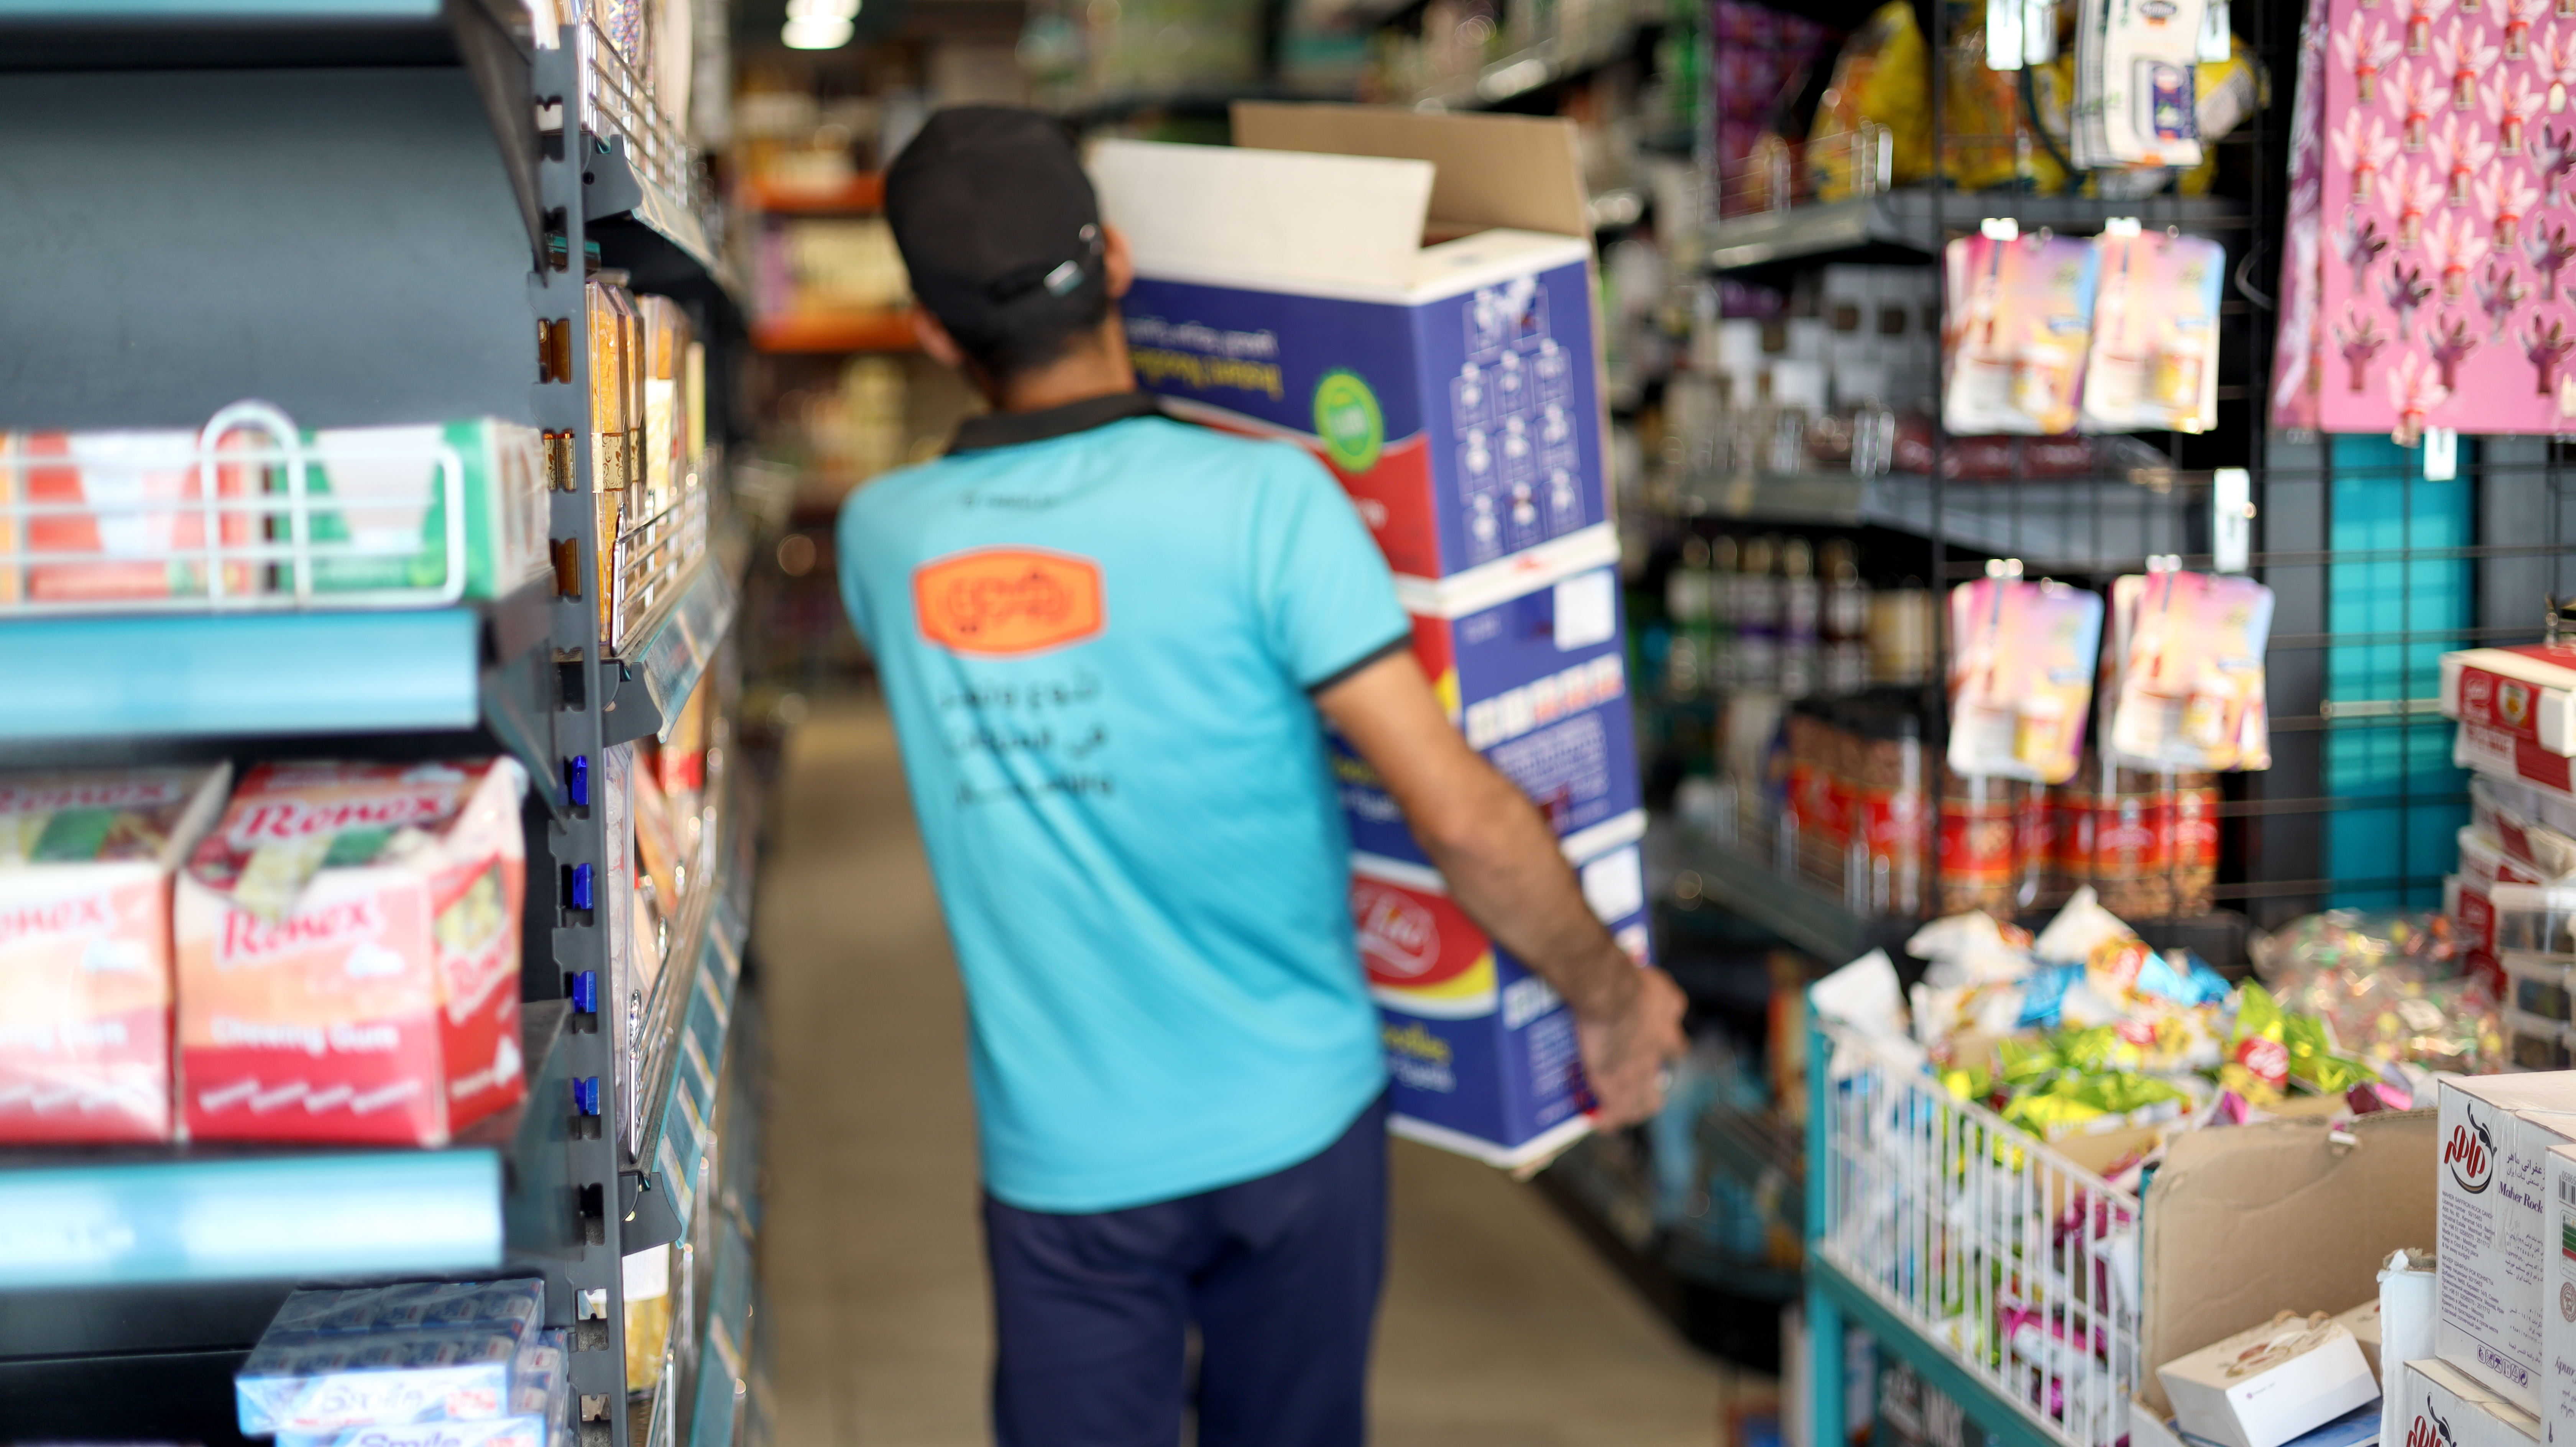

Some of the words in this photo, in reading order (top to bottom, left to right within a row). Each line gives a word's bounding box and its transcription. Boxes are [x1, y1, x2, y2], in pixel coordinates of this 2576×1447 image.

[2444, 1124, 2485, 1178] ماهر
[2507, 1152, 2519, 1165] ماهر
[2507, 1167, 2516, 1177] ایران
[2517, 1172, 2525, 1181] نبات
[2442, 1191, 2454, 1201] MAHER
[2455, 1196, 2471, 1209] SAFFRON
[2471, 1204, 2481, 1214] ROCK
[2499, 1181, 2522, 1203] Maher
[2523, 1193, 2543, 1214] Rock
[2442, 1198, 2454, 1208] License
[2454, 1204, 2466, 1213] number
[2468, 1211, 2482, 1222] 50/15463
[2462, 1215, 2475, 1226] Keramat
[2442, 1213, 2455, 1224] Industrial
[2456, 1219, 2466, 1229] Estate
[2468, 1226, 2482, 1237] Mashhad
[2442, 1227, 2450, 1236] Made
[2463, 1237, 2477, 1249] Mashhad
[2442, 1235, 2450, 1244] Keep
[2476, 1237, 2490, 1249] 2511712
[2442, 1254, 2453, 1263] МАХЕР
[2454, 1261, 2469, 1272] ШАФРАН
[2458, 1251, 2470, 1261] sunlight
[2441, 1276, 2463, 1291] Промышленной
[2442, 1262, 2452, 1271] Номер
[2468, 1275, 2482, 1287] 50/15463
[2460, 1293, 2474, 1306] 32585070
[2477, 1302, 2490, 1314] 2511712
[2466, 1282, 2479, 1293] Керамат
[2488, 1294, 2499, 1304] Самен
[2441, 1290, 2455, 1302] Сделано
[2458, 1299, 2468, 1309] Иране
[2471, 1306, 2484, 1319] Мешхед
[2441, 1298, 2454, 1309] Хранить
[2479, 1320, 2489, 1328] сухом
